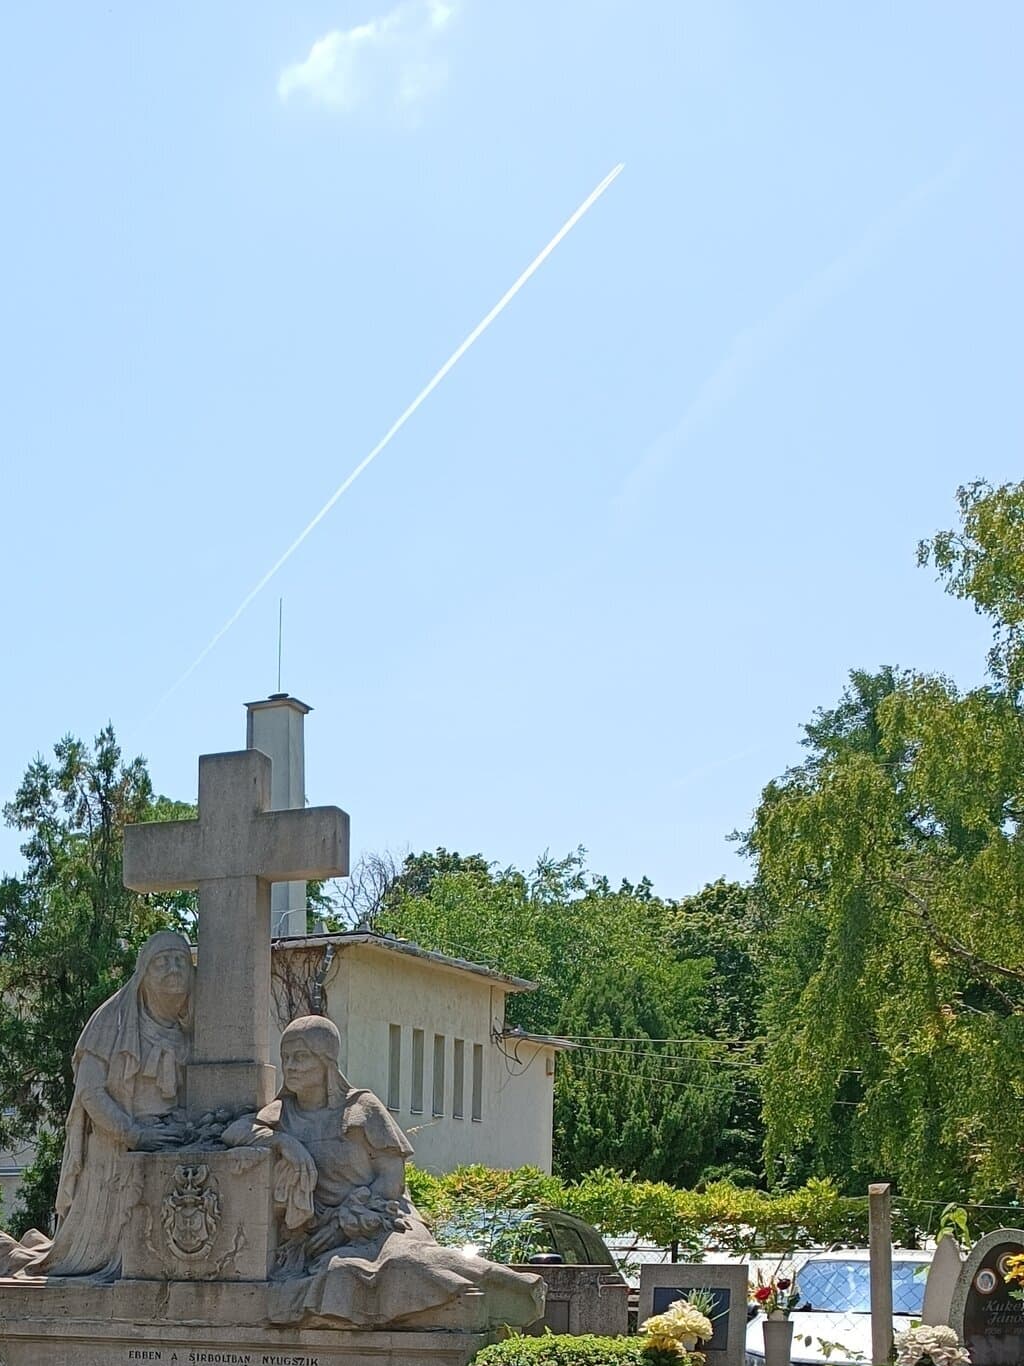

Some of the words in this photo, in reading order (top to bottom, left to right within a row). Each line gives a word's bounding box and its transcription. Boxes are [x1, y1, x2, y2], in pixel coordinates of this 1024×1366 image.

[128, 1350, 162, 1360] EBBEN
[171, 1352, 178, 1361] A
[262, 1355, 319, 1366] NYUGSZIK
